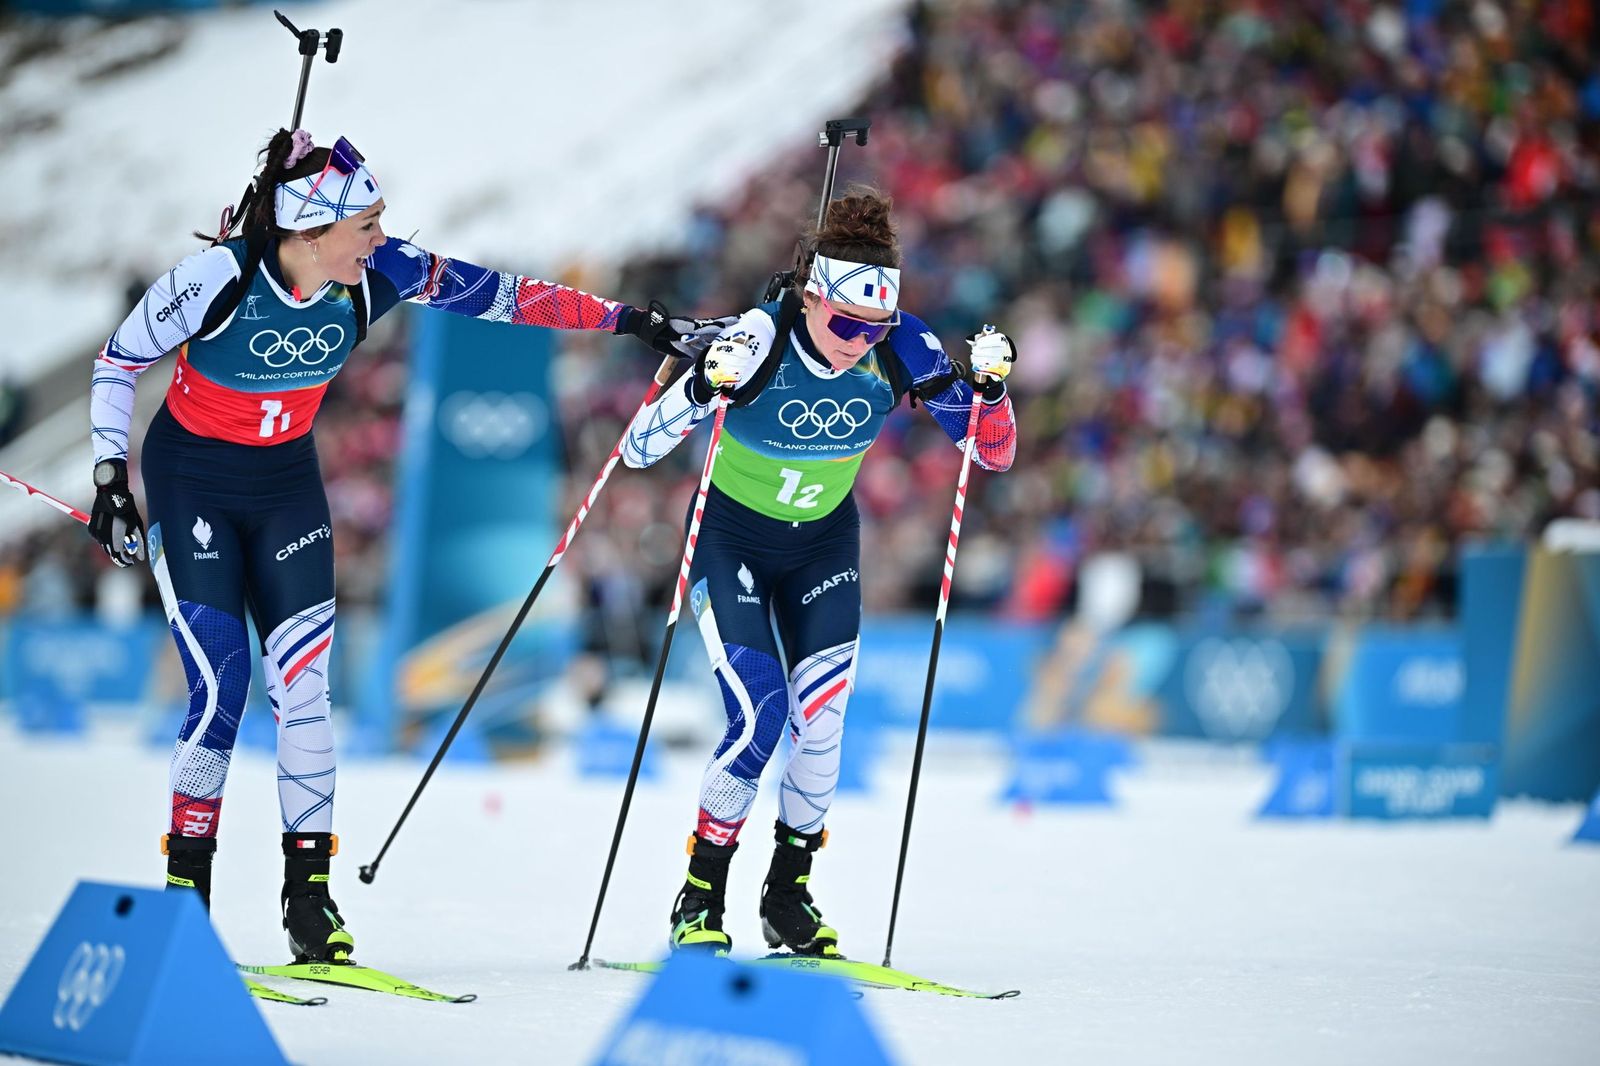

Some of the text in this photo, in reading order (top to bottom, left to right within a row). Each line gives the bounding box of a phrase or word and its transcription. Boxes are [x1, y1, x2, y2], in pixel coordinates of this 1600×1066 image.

[156, 289, 190, 322] CRAFT
[235, 371, 281, 380] MILANO
[282, 369, 326, 379] CORTINA
[762, 439, 807, 450] MILANO
[275, 528, 323, 561] CRAFT
[193, 550, 220, 560] FRANCE
[801, 571, 850, 605] CRAFT
[791, 959, 821, 969] FISCHER
[309, 965, 332, 976] FISCHER
